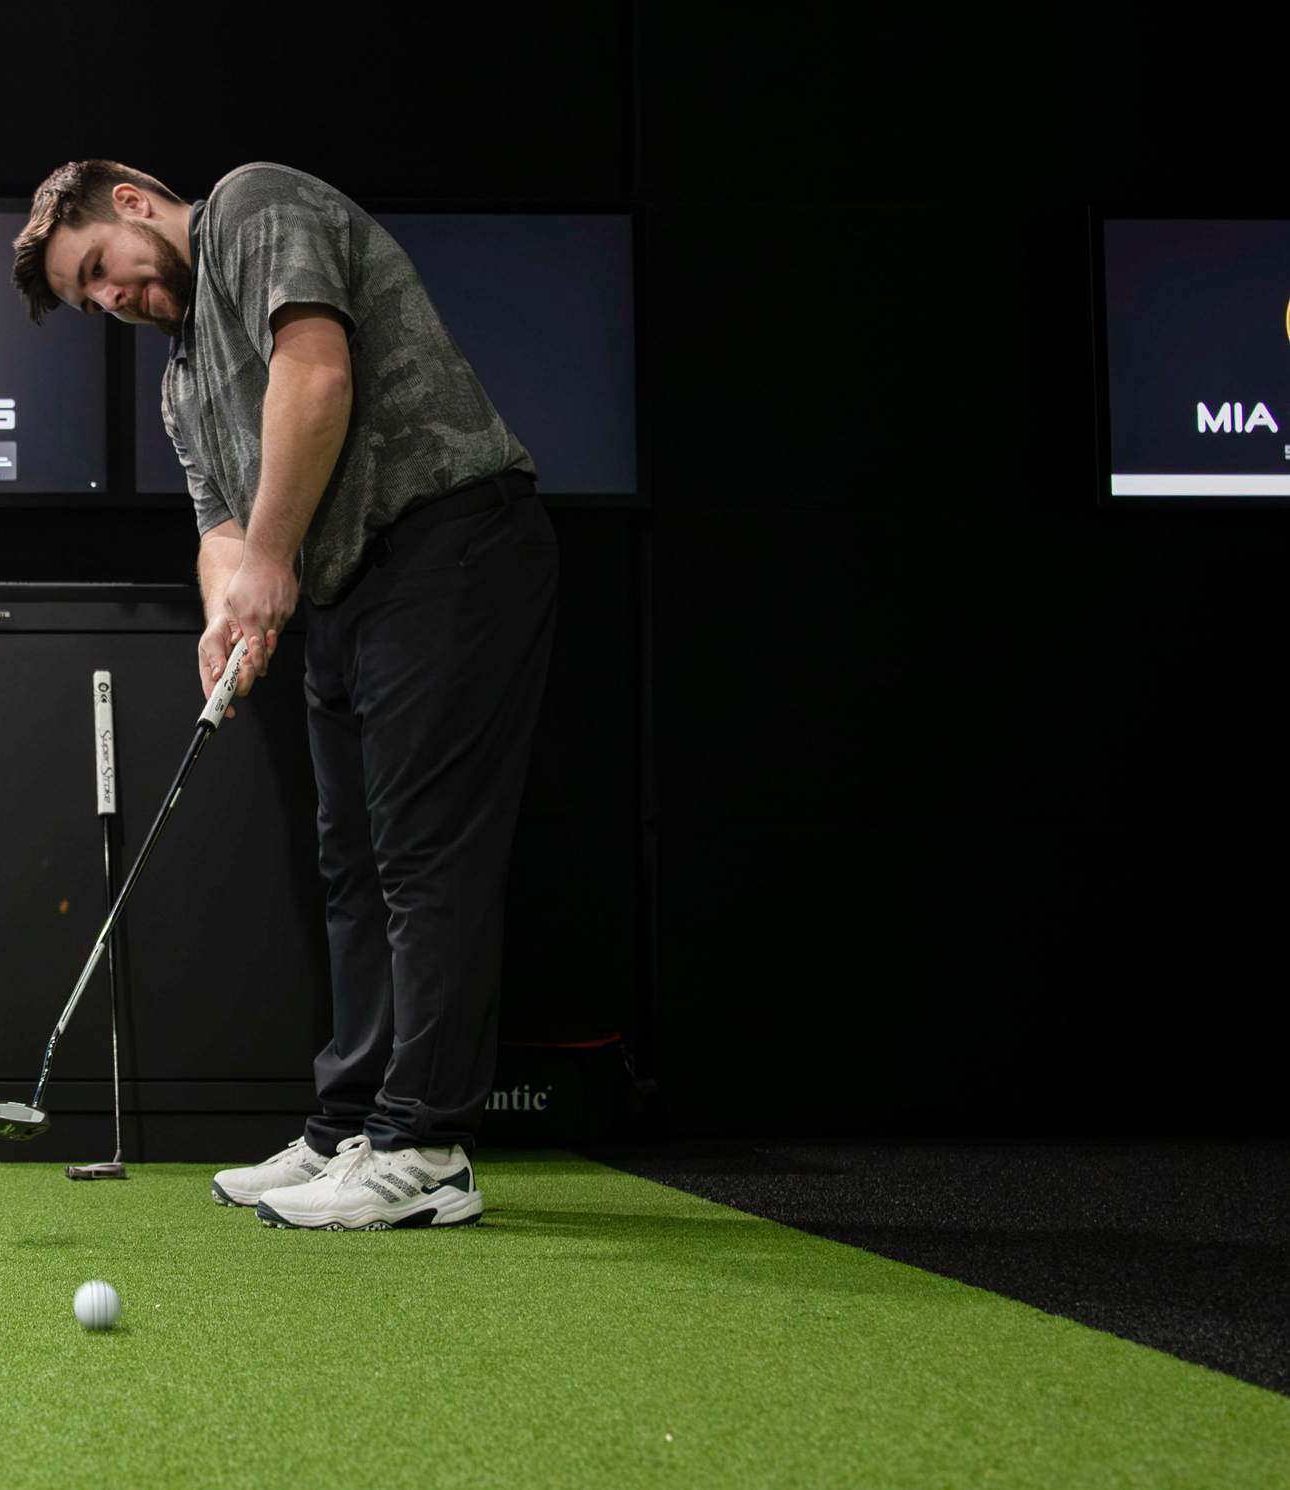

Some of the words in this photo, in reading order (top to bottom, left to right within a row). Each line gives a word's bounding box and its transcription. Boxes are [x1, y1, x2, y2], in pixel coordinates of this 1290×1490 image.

[1197, 402, 1279, 433] MIA
[99, 728, 112, 764] Super
[100, 765, 114, 803] Stroke
